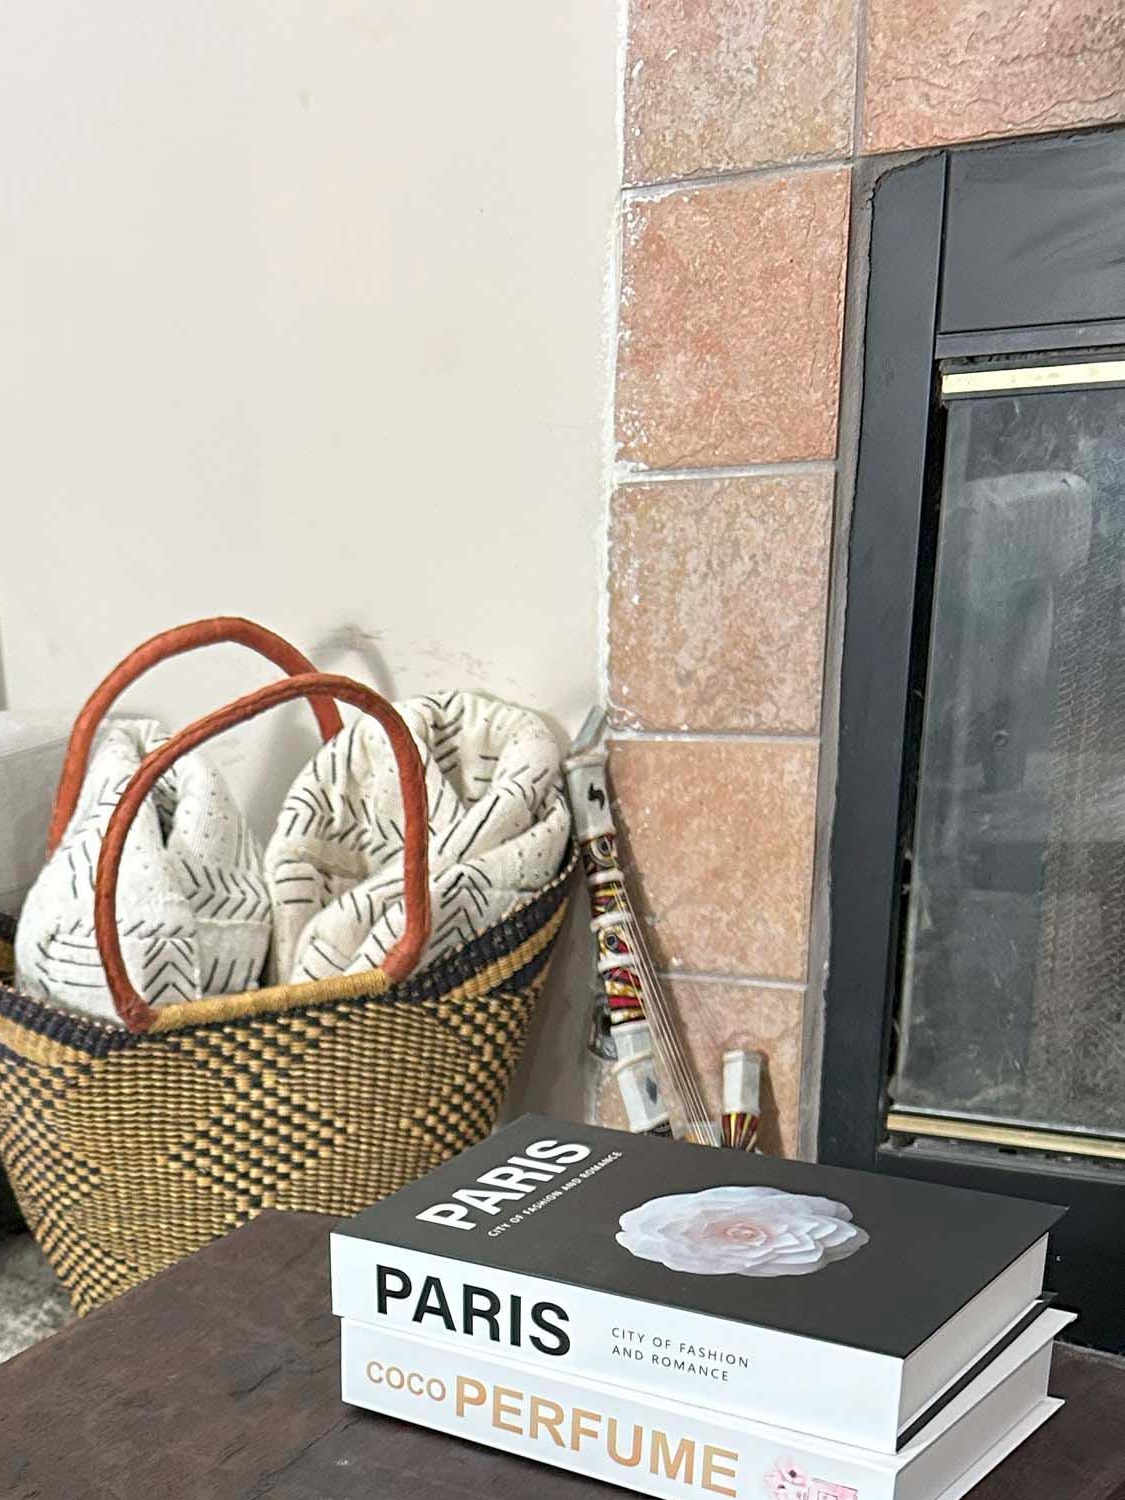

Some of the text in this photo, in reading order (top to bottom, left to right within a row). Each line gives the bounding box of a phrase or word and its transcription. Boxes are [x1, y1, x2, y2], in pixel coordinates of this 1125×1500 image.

[415, 1139, 591, 1231] PARIS
[487, 1151, 624, 1238] CITY OF FASHION AND ROMANCE
[376, 1263, 571, 1357] PARIS
[611, 1326, 750, 1369] CITY OF FASHION
[611, 1344, 730, 1382] AND ROMANCE
[365, 1360, 739, 1499] COCO PERFUME
